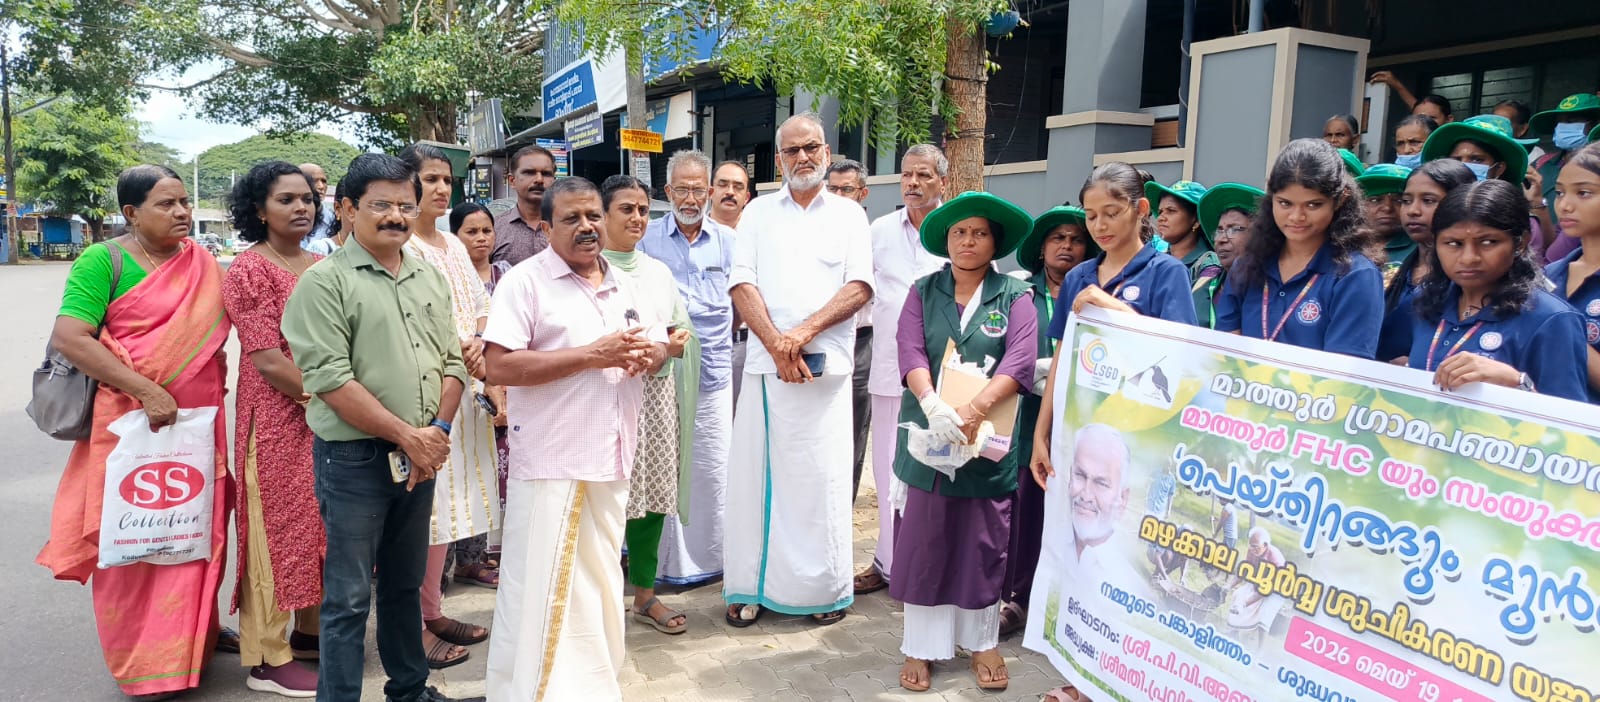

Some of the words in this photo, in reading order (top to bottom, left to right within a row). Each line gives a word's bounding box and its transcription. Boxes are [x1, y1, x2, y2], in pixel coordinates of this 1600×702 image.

[1093, 363, 1119, 380] LSGD
[1210, 372, 1336, 422] മാത്തൂർ
[1182, 407, 1286, 450] മാത്തൂർ
[1292, 432, 1370, 474] FHC
[1382, 461, 1436, 497] യും
[133, 467, 191, 504] SS
[119, 511, 199, 530] Collection
[1139, 516, 1238, 574] മഴക്കാല
[1101, 581, 1156, 618] നമ്മുടെ
[1482, 558, 1600, 634] മുൻ
[1301, 631, 1351, 665] 2026
[1355, 656, 1417, 690] മെയ്
[1418, 681, 1440, 702] 19
